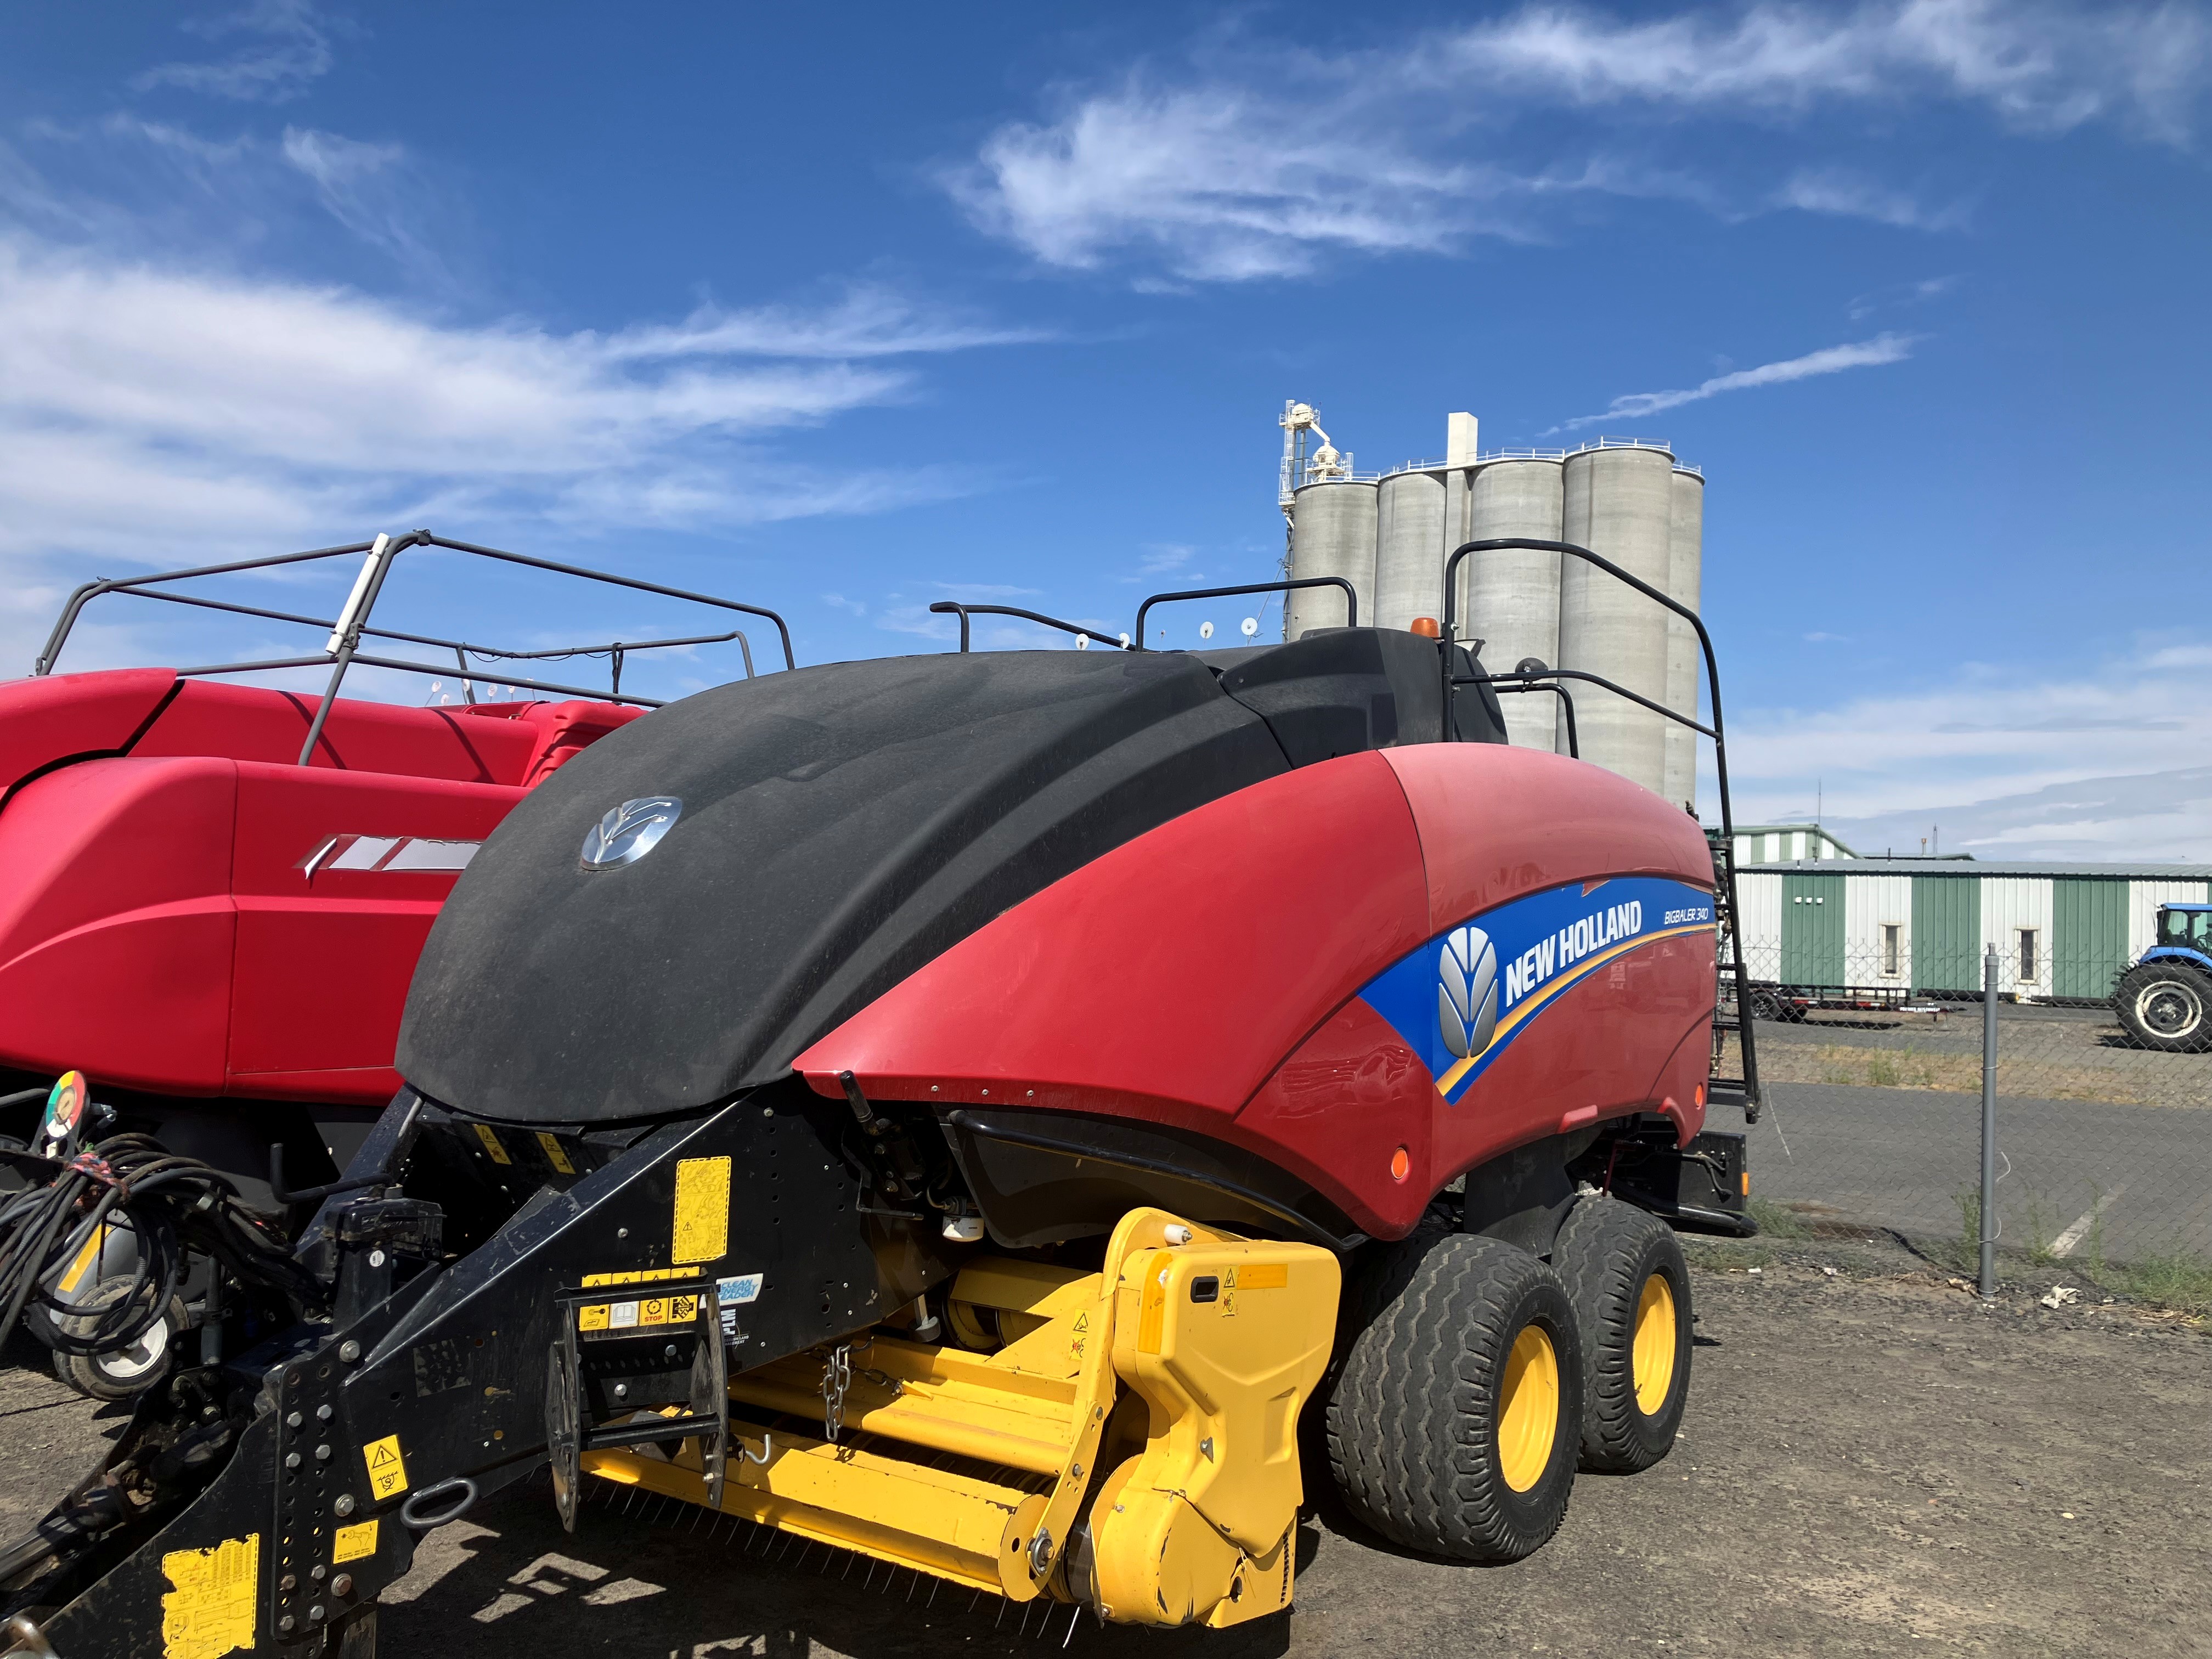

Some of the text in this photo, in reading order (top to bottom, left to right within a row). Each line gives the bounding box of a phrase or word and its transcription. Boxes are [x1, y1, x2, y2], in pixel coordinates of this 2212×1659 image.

[1664, 908, 1708, 925] BIGBALER 340
[1506, 900, 1642, 1007] NEW HOLLAND
[721, 1279, 753, 1289] CLEAN
[720, 1290, 754, 1300] EADER
[720, 1308, 736, 1335] PLM
